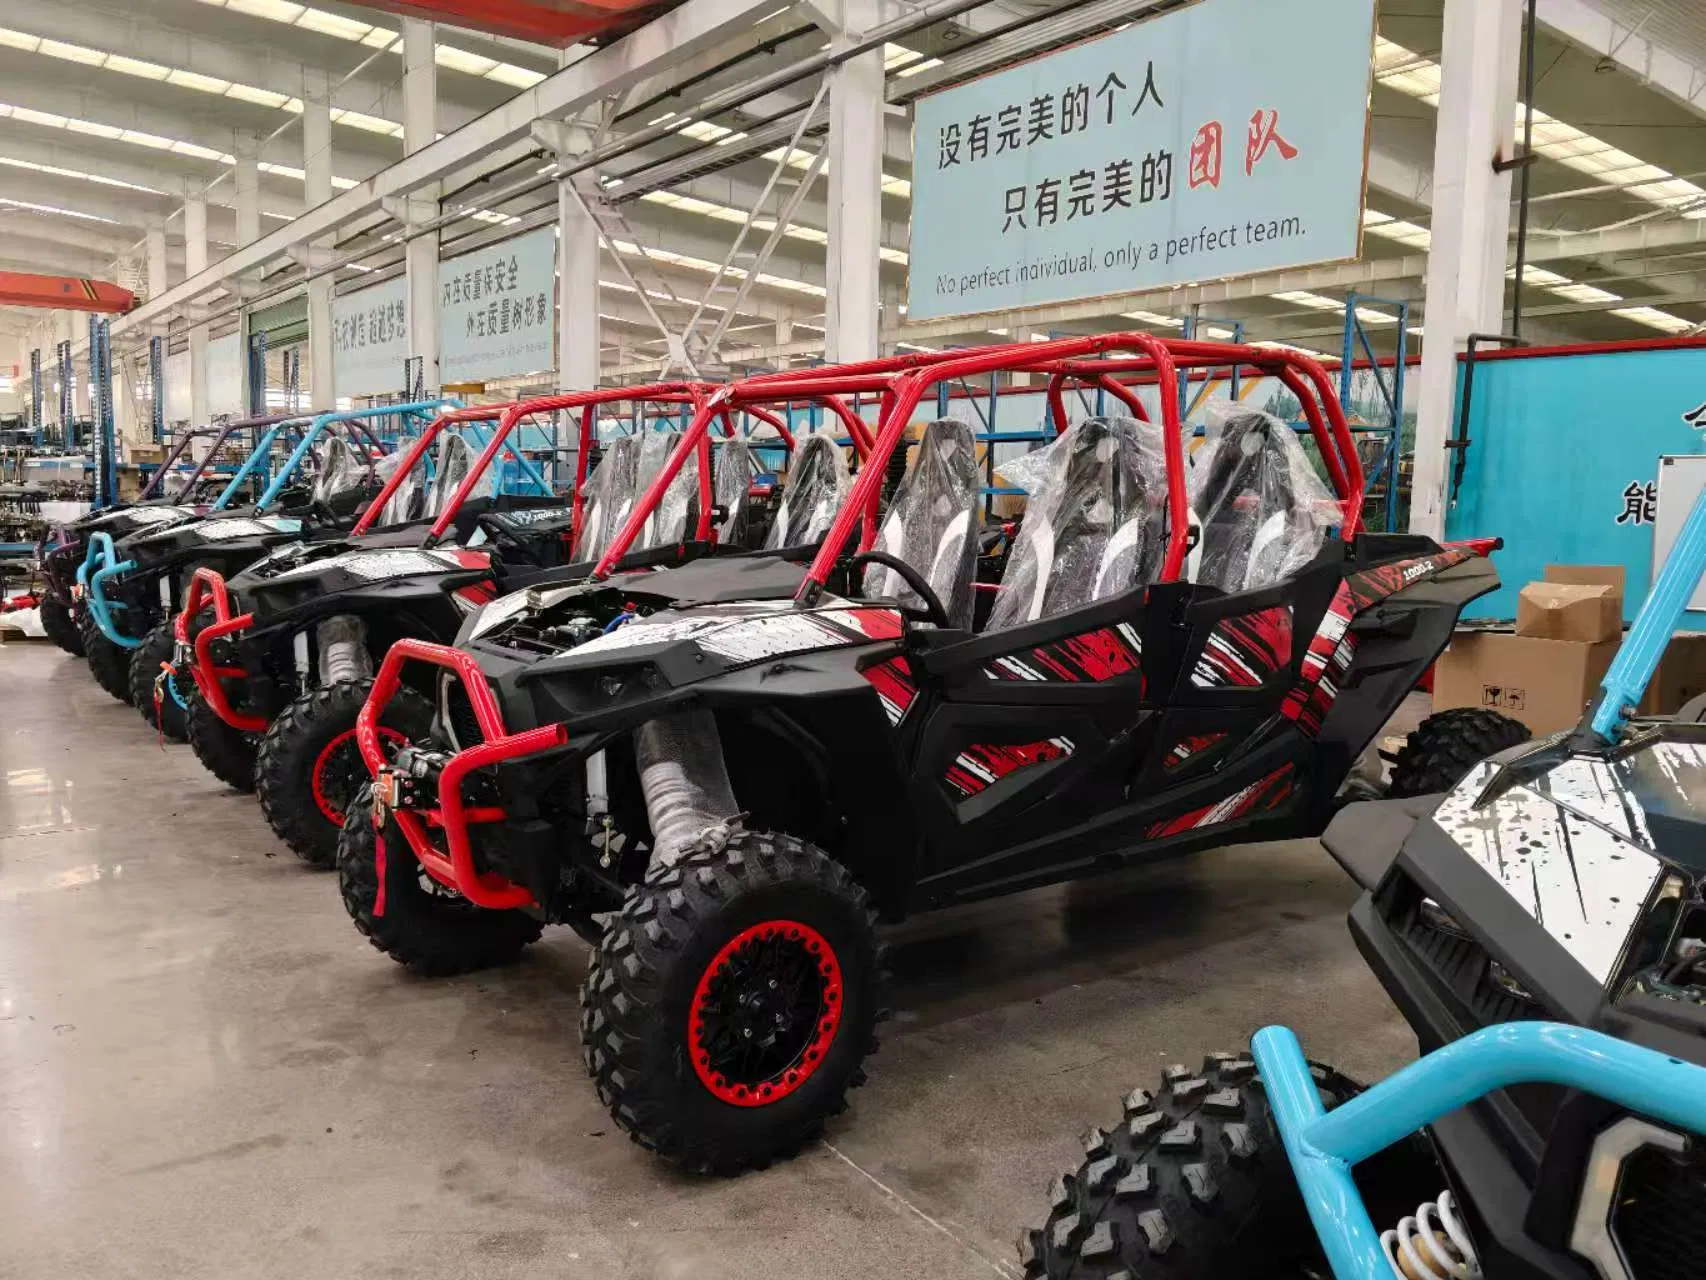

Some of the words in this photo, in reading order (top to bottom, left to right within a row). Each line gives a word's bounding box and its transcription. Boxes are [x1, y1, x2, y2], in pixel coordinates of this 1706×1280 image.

[938, 60, 1164, 169] 没有完美的个人
[936, 274, 956, 295] No
[960, 265, 1011, 296] perfect
[1015, 247, 1097, 283] individual,
[1104, 240, 1142, 270] only
[1149, 243, 1158, 261] a
[1166, 226, 1237, 264] perfect
[1246, 216, 1306, 244] team.
